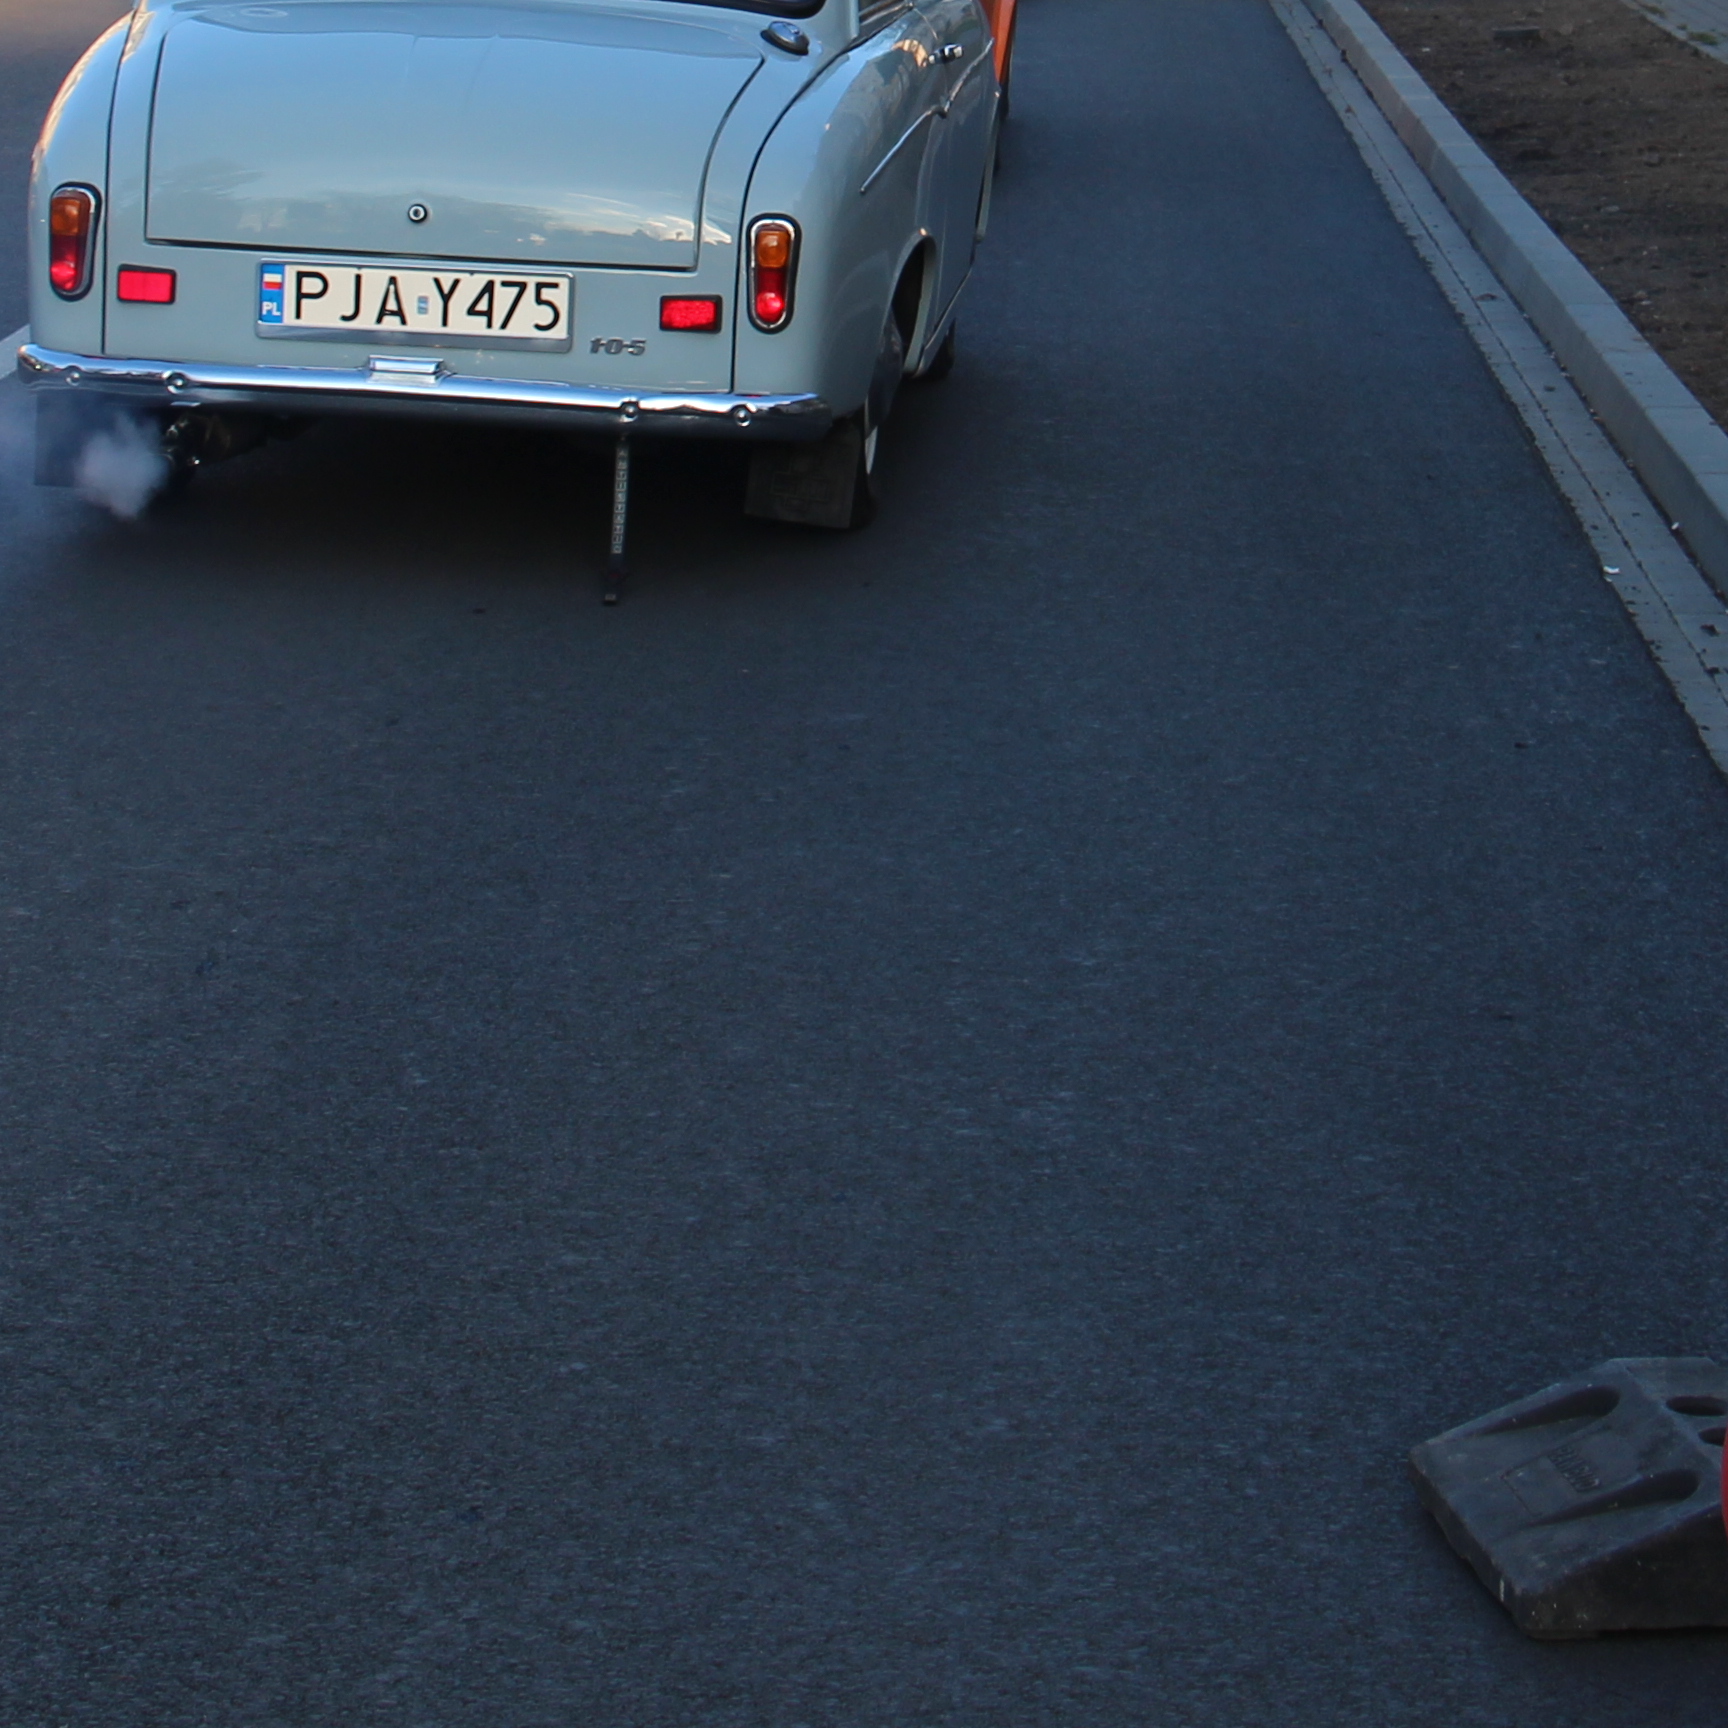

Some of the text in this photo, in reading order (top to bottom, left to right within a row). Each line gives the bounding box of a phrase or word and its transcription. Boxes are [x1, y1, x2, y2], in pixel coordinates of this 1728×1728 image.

[262, 302, 281, 316] PL
[295, 270, 561, 332] PJA Y475
